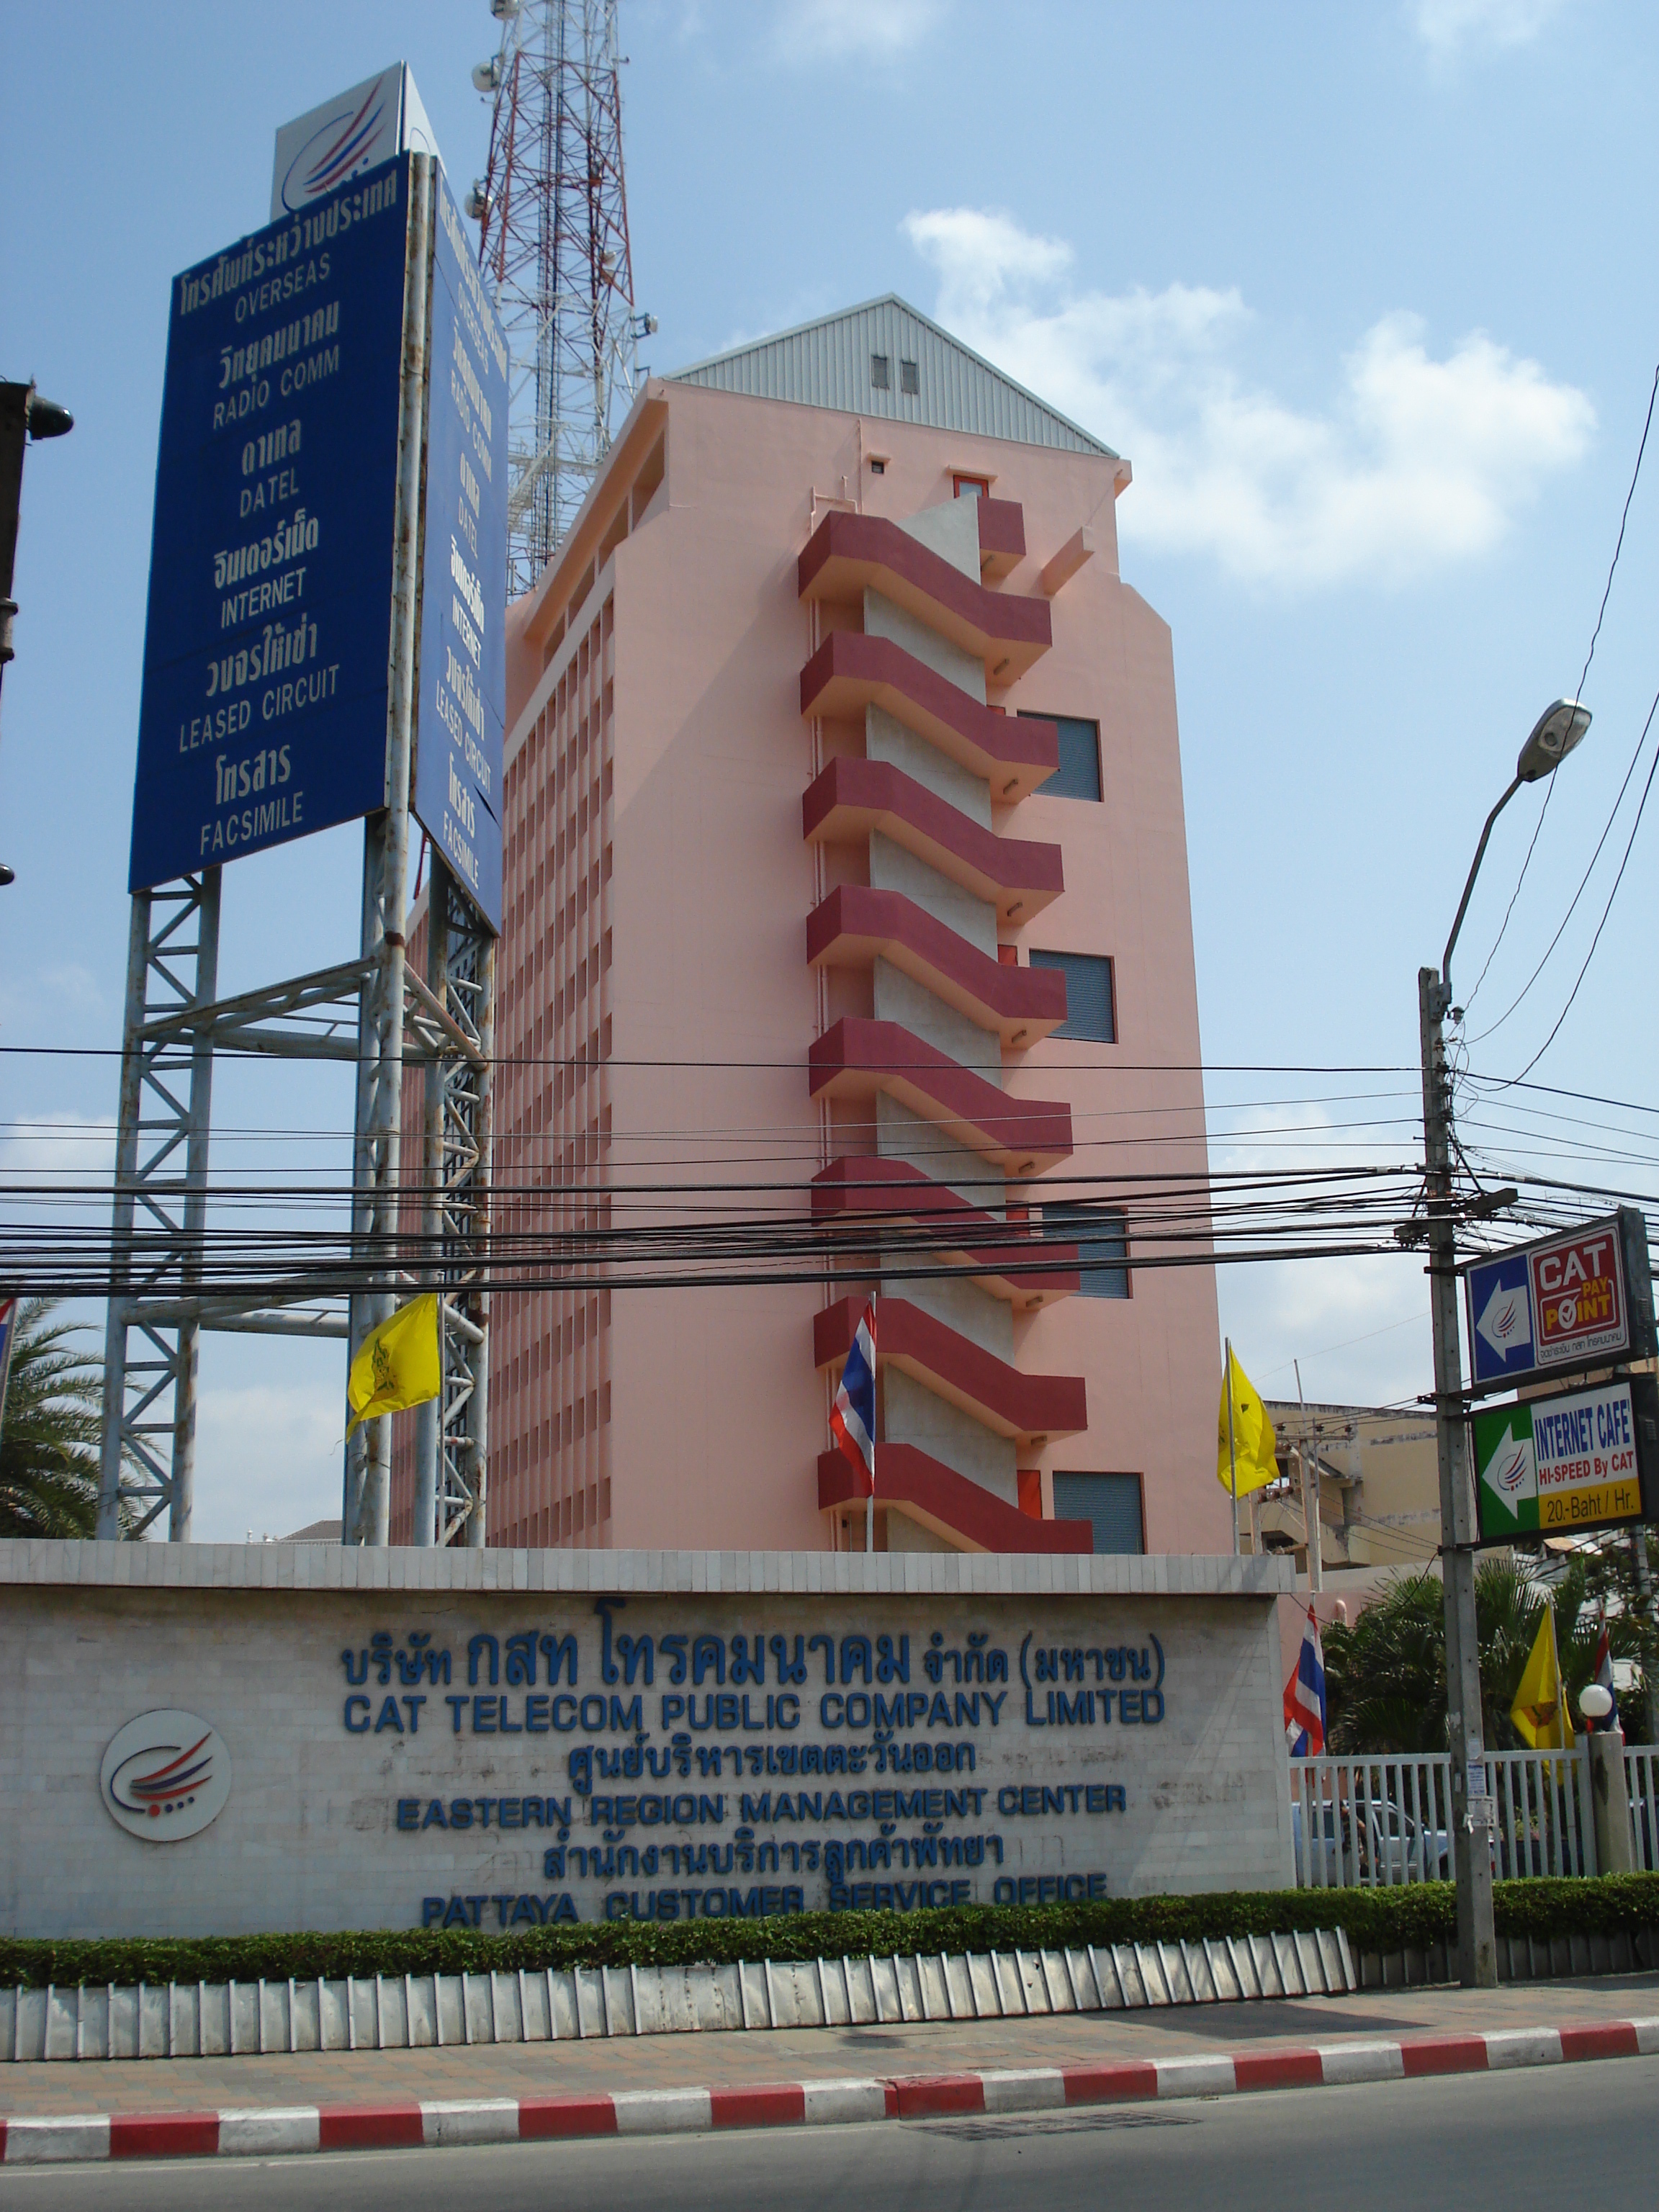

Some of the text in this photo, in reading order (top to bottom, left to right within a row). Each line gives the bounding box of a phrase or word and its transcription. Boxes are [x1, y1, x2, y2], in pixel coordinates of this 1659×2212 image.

[235, 252, 331, 323] OVERSEAS
[219, 300, 338, 389] วิทยุคมนาคม
[458, 282, 489, 376] OVERSEAS
[213, 344, 339, 430] RADIO COMM
[241, 418, 302, 476] ดาเทล
[451, 368, 492, 483] RADIO COMM
[240, 467, 299, 518] DATEL
[459, 496, 478, 560] DATEL
[221, 567, 306, 629] INTERNET
[206, 612, 318, 697] วงจรให้เช่า
[452, 594, 481, 670] INTERNET
[179, 663, 340, 753] LEASED CIRCUIT
[436, 680, 491, 794] LEASED CIRCUIT
[216, 744, 291, 805] โทรสาร
[449, 751, 475, 840] โทรสาร
[200, 791, 303, 856] FACSIMILE
[444, 810, 479, 890] FACSIMILE
[1539, 1241, 1607, 1291] CAT
[1582, 1276, 1609, 1297] PAY
[1534, 1407, 1594, 1462] INTERNET
[1539, 1450, 1634, 1485] HI-SPEED By CAT
[1614, 1487, 1635, 1511] Hr.
[341, 1596, 1165, 1689] บริษัท กสท โทรคมนาคม จำกัด (มหาชน)
[344, 1689, 1165, 1734] CAT TELECOM PUBLIC COMPANY LIMITED
[569, 1730, 976, 1794] ศูนย์บริหารเขตตะวันออก
[397, 1783, 1126, 1830] EASTERN REGION MANAGEMENT CENTER
[543, 1822, 1004, 1883] สำนักงานบริการลูกค้าพัทยา
[421, 1872, 1107, 1928] PATTAYA CUSTOMER SERVICE OFFICE
